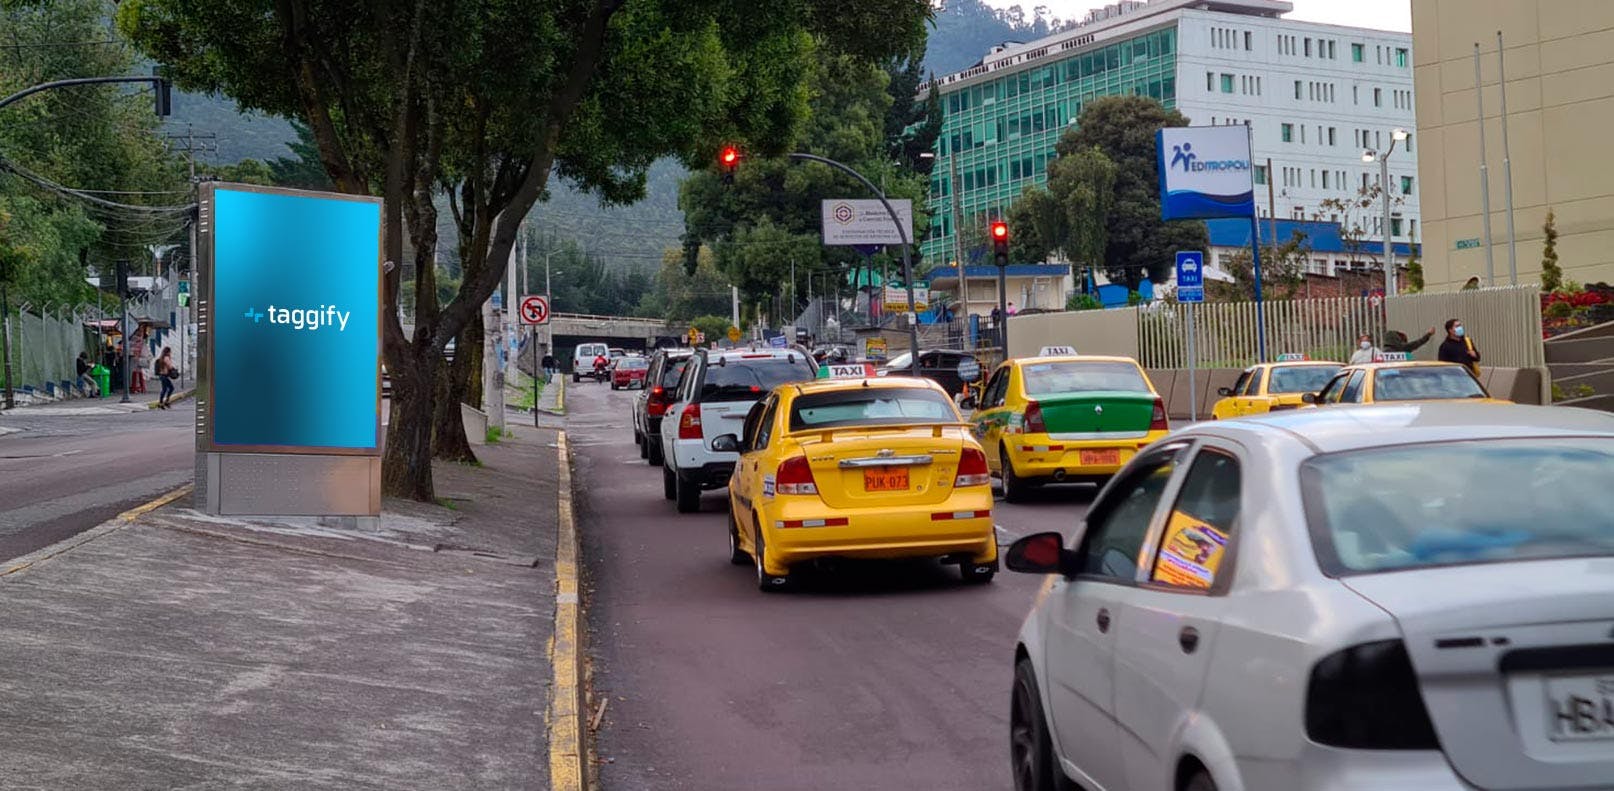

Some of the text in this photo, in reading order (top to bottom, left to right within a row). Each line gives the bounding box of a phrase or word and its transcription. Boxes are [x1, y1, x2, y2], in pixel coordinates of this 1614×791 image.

[268, 305, 350, 331] taggify
[1048, 347, 1068, 355] TAXI
[1286, 353, 1304, 361] TAXI
[1385, 353, 1405, 361] TAXI
[832, 366, 863, 376] TAXI
